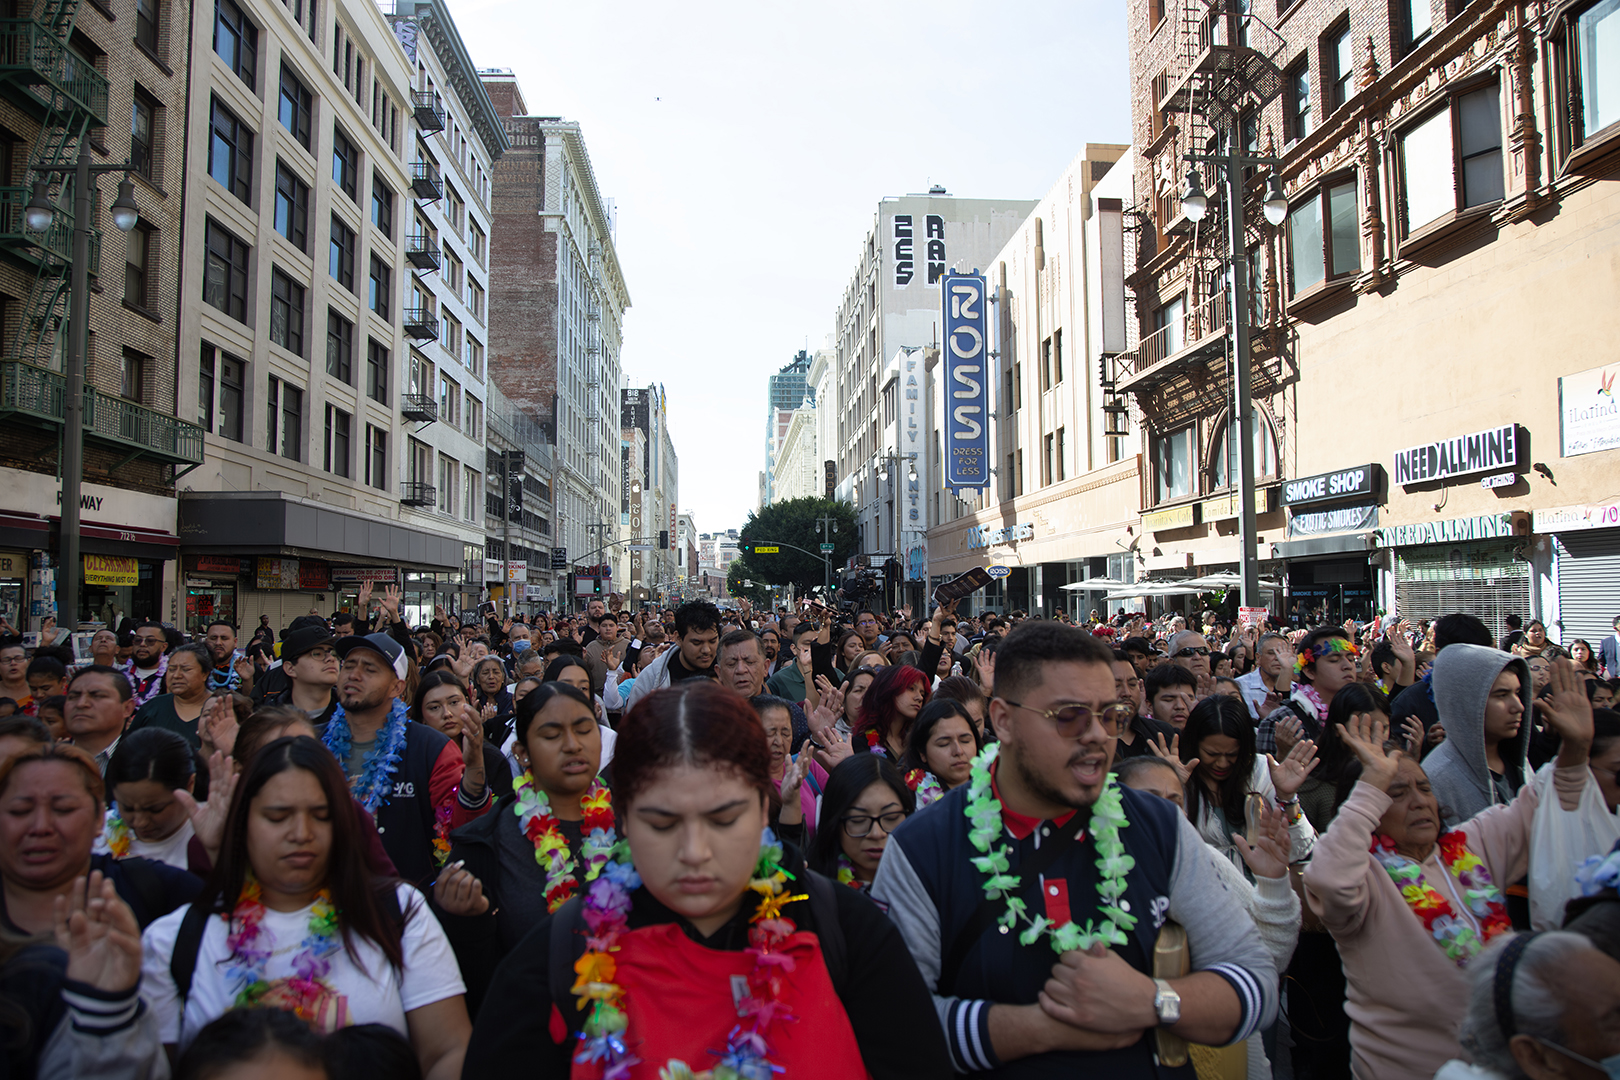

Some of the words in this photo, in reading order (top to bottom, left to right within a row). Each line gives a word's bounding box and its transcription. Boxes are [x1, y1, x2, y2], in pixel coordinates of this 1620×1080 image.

[950, 285, 983, 440] ROSS
[906, 361, 918, 442] FAMILY
[952, 447, 983, 457] DRESS
[958, 457, 978, 466] FOR
[1395, 426, 1514, 484] INEEDALLMINE
[956, 466, 980, 476] LESS
[908, 451, 920, 521] PNTS
[1286, 477, 1326, 502] SMOKE
[1329, 470, 1364, 494] SHOP
[1481, 474, 1514, 488] CLOTHING
[1204, 503, 1228, 518] Comida
[1300, 512, 1327, 530] EXOTIC
[1328, 507, 1363, 529] SMOKES
[576, 565, 609, 576] GLOBE
